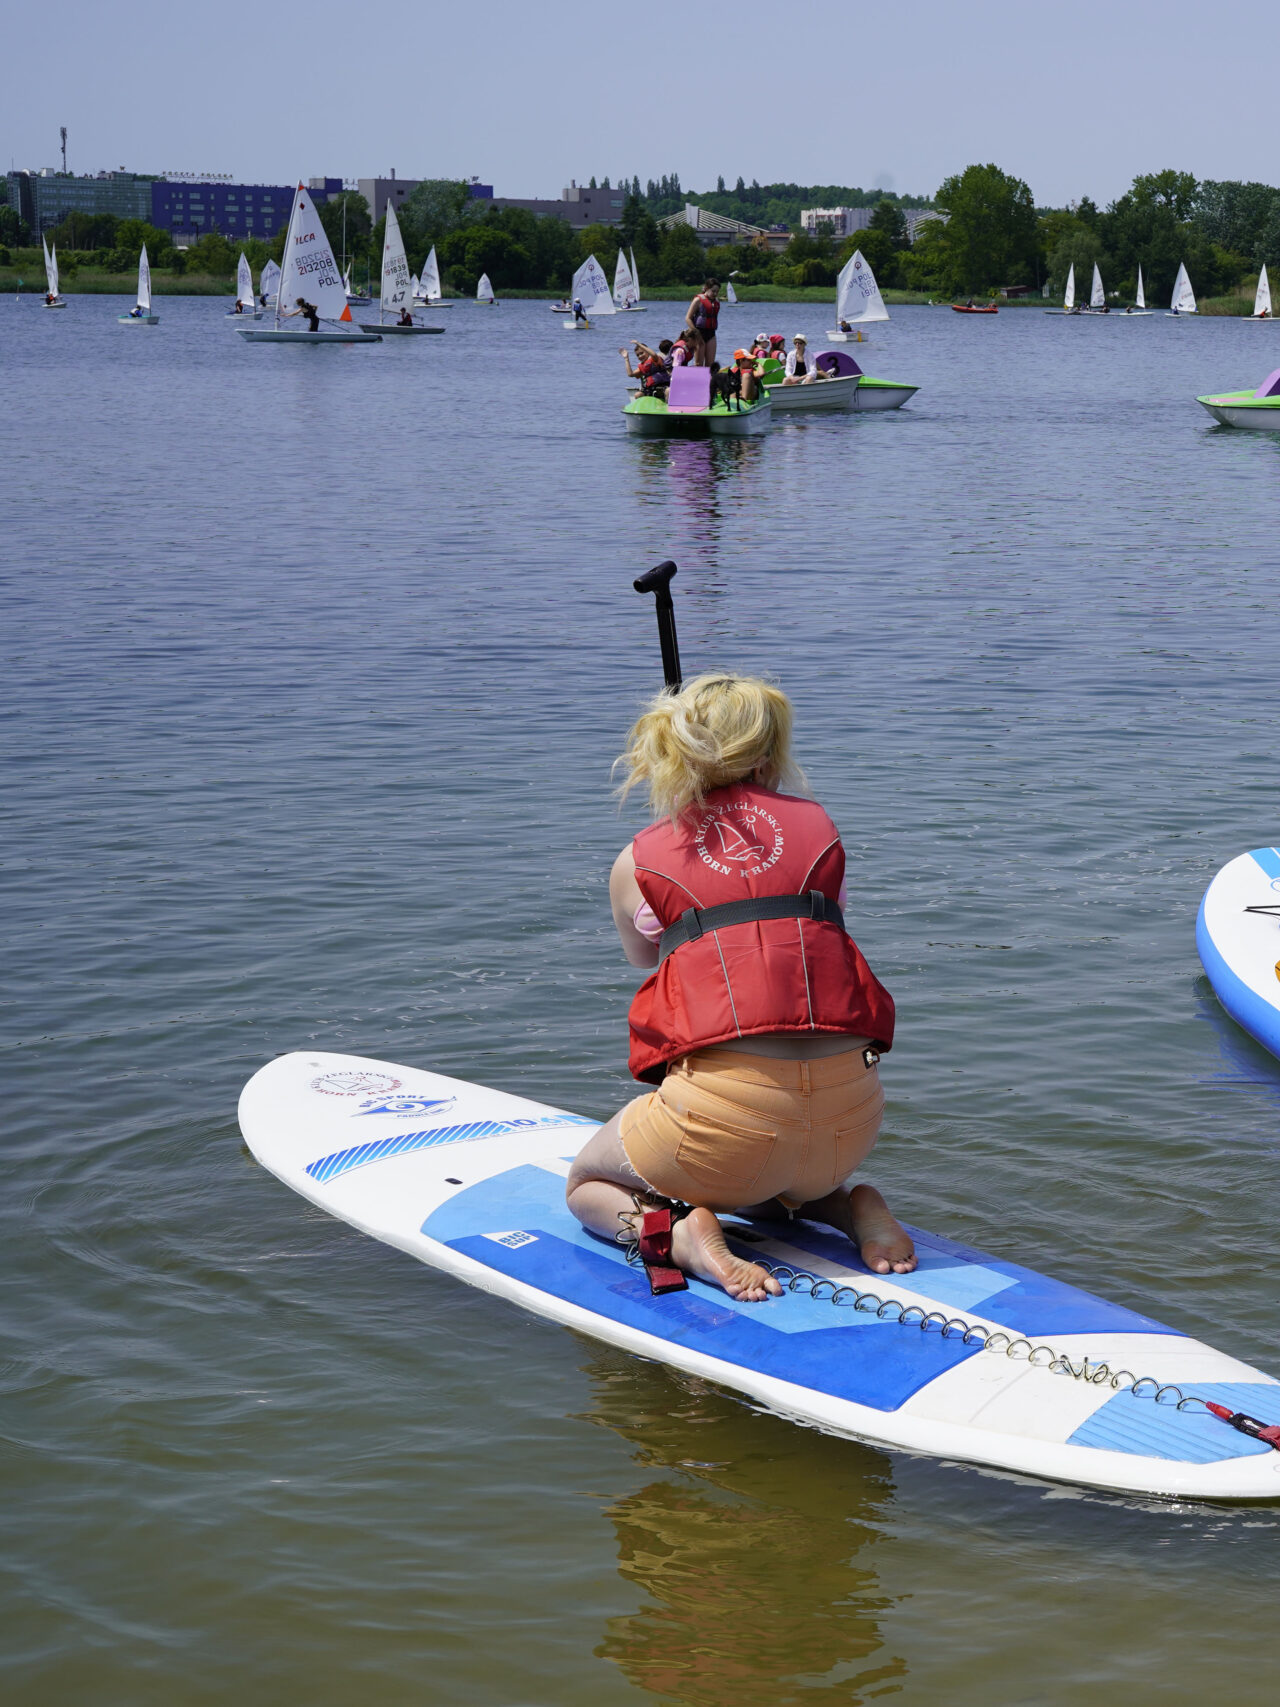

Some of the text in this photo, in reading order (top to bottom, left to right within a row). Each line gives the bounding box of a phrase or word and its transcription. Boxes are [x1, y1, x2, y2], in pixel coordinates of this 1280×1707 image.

[295, 233, 316, 245] ILCA
[298, 257, 333, 276] 213208
[318, 276, 339, 288] POL
[396, 278, 409, 288] POL
[858, 273, 872, 282] POL
[392, 290, 406, 304] 4.7
[861, 285, 876, 298] 1917
[827, 356, 840, 378] 3
[695, 814, 716, 843] KLUB
[697, 834, 784, 879] HORN KRAKÓW
[498, 1231, 525, 1243] BIC
[507, 1235, 531, 1246] SUP
